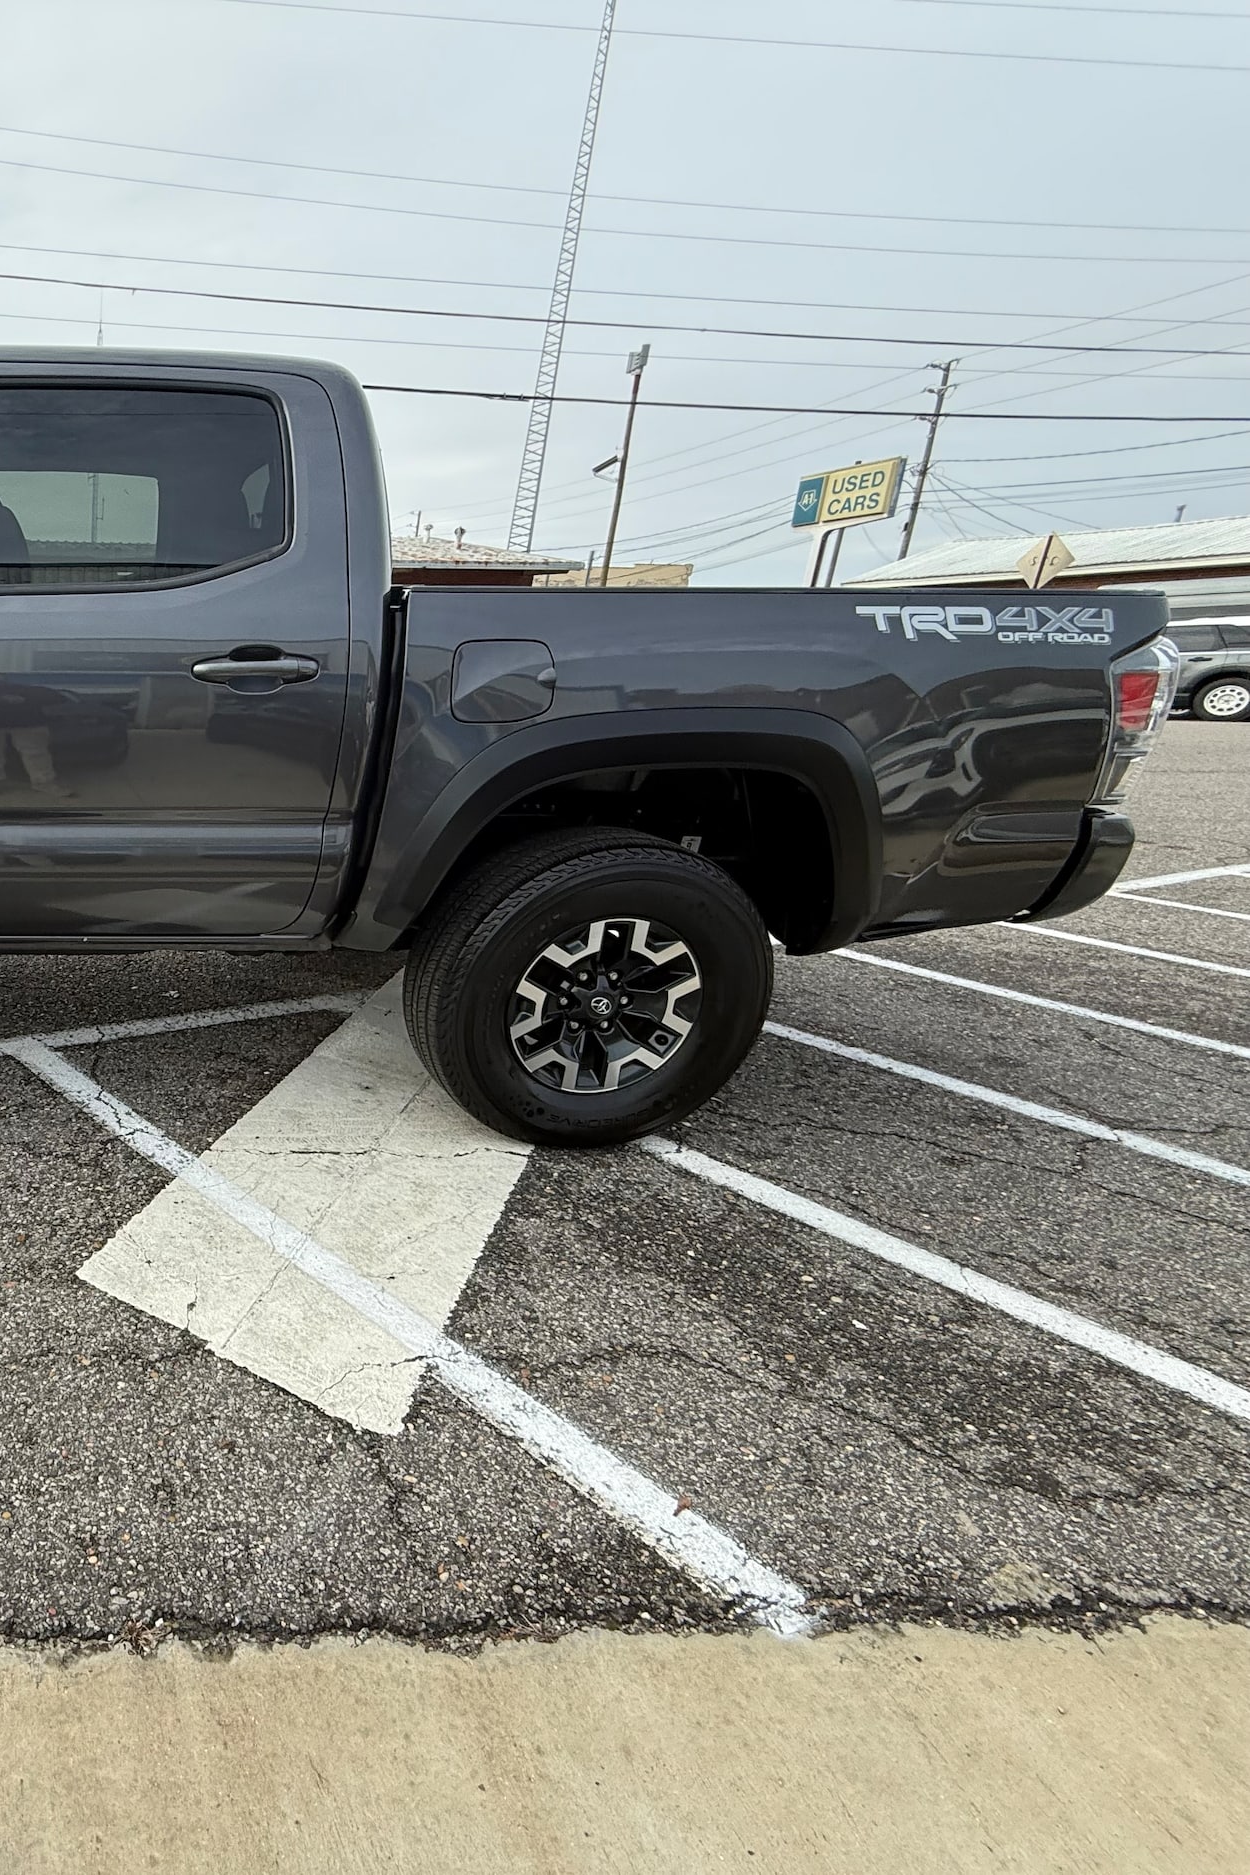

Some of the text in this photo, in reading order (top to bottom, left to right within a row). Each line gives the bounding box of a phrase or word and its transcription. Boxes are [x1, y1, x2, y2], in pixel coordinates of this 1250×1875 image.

[832, 470, 885, 495] USED
[827, 492, 881, 516] CARS
[855, 606, 995, 642] TRD
[997, 631, 1112, 646] OFF ROAD
